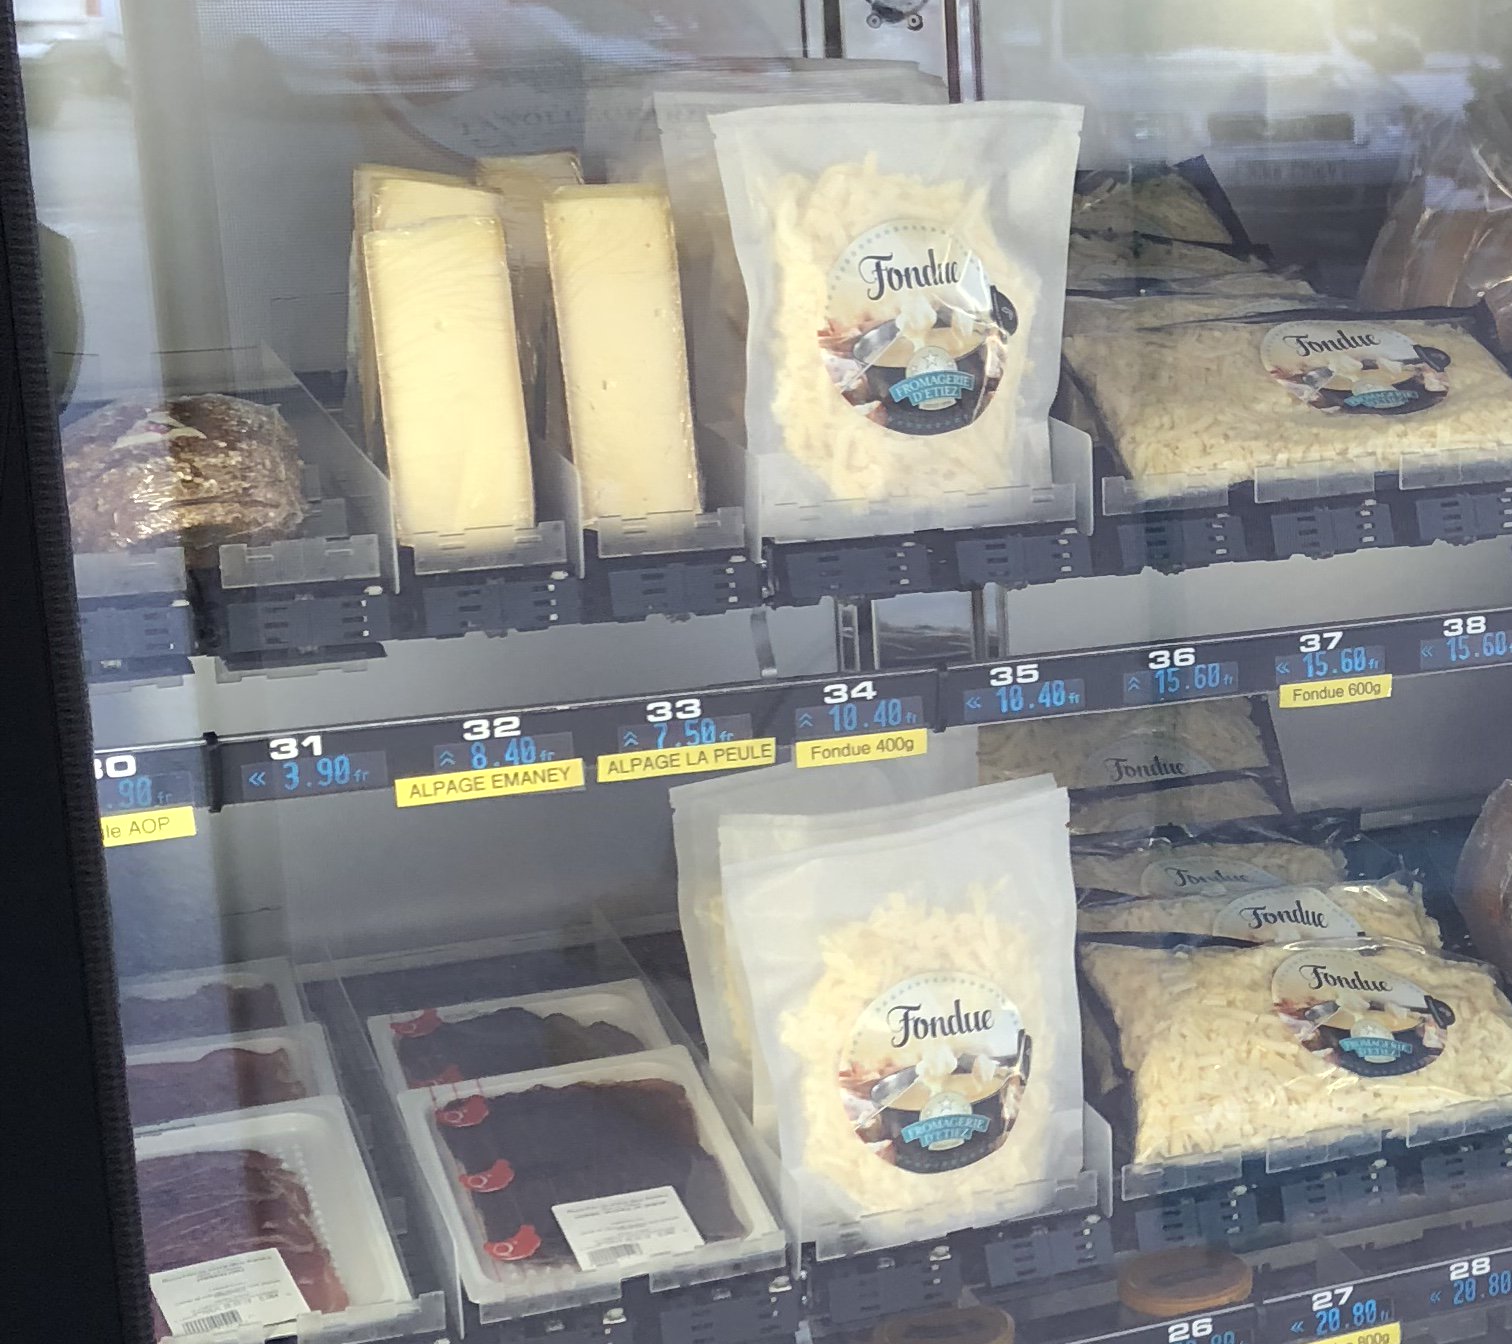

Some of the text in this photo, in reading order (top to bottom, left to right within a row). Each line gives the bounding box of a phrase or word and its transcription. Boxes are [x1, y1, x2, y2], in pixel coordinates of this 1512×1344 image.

[858, 248, 960, 301] Fondue
[1282, 329, 1382, 357] Fondue
[893, 372, 973, 397] FROMAGERIE
[1442, 615, 1487, 638] 38
[1298, 631, 1344, 654] 37
[1445, 630, 1507, 663] 15.60
[1148, 647, 1196, 670] 36
[1302, 646, 1368, 679] 15.60
[988, 663, 1041, 688] 35
[1154, 664, 1221, 697] 15.60
[822, 680, 878, 706] 34
[999, 679, 1066, 715] 10.40
[1291, 681, 1383, 702] Fondue 600g
[646, 698, 702, 723] 33
[828, 698, 902, 733] 10.40
[462, 716, 522, 742] 32
[653, 717, 717, 750] 7.50
[269, 734, 323, 761] 31
[470, 735, 537, 770] 8.40
[606, 742, 773, 776] ALPAGE LA PEULE
[809, 734, 916, 762] Fondue 400g
[282, 754, 351, 792] 3.90
[408, 765, 570, 801] ALPAGE EMANEY
[128, 816, 171, 837] AOP
[1239, 900, 1330, 930] Fondue
[1298, 963, 1394, 993] Fondue
[886, 999, 995, 1048] Fondue
[906, 1117, 986, 1140] FROMAGERIE
[1449, 1257, 1491, 1282] 28
[1311, 1285, 1355, 1311] 27
[1452, 1270, 1512, 1305] 20.80
[1167, 1316, 1214, 1343] 26
[1315, 1298, 1378, 1336] 20.80
